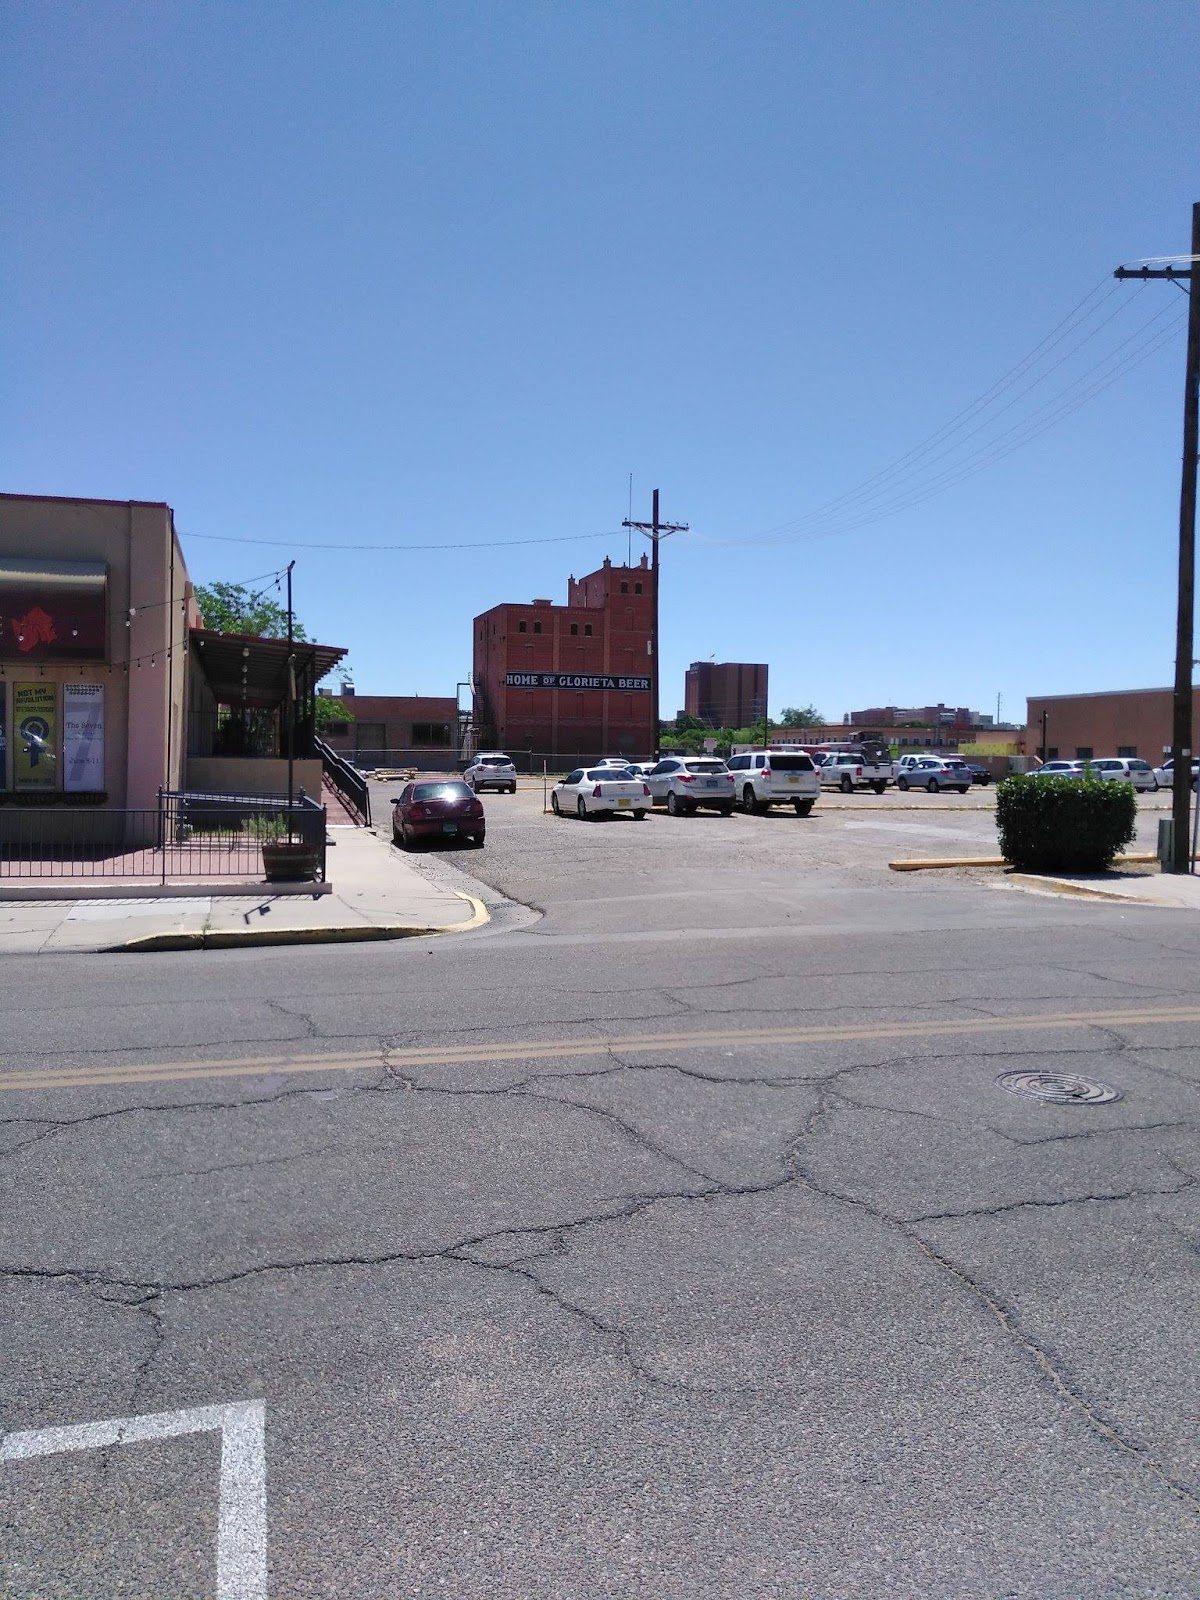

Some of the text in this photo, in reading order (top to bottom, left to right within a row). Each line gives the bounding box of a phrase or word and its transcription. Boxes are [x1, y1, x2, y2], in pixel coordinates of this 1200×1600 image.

[506, 674, 649, 689] HOME OF GLORIETA BEER
[17, 688, 47, 697] NOT MY
[82, 722, 102, 730] Seven
